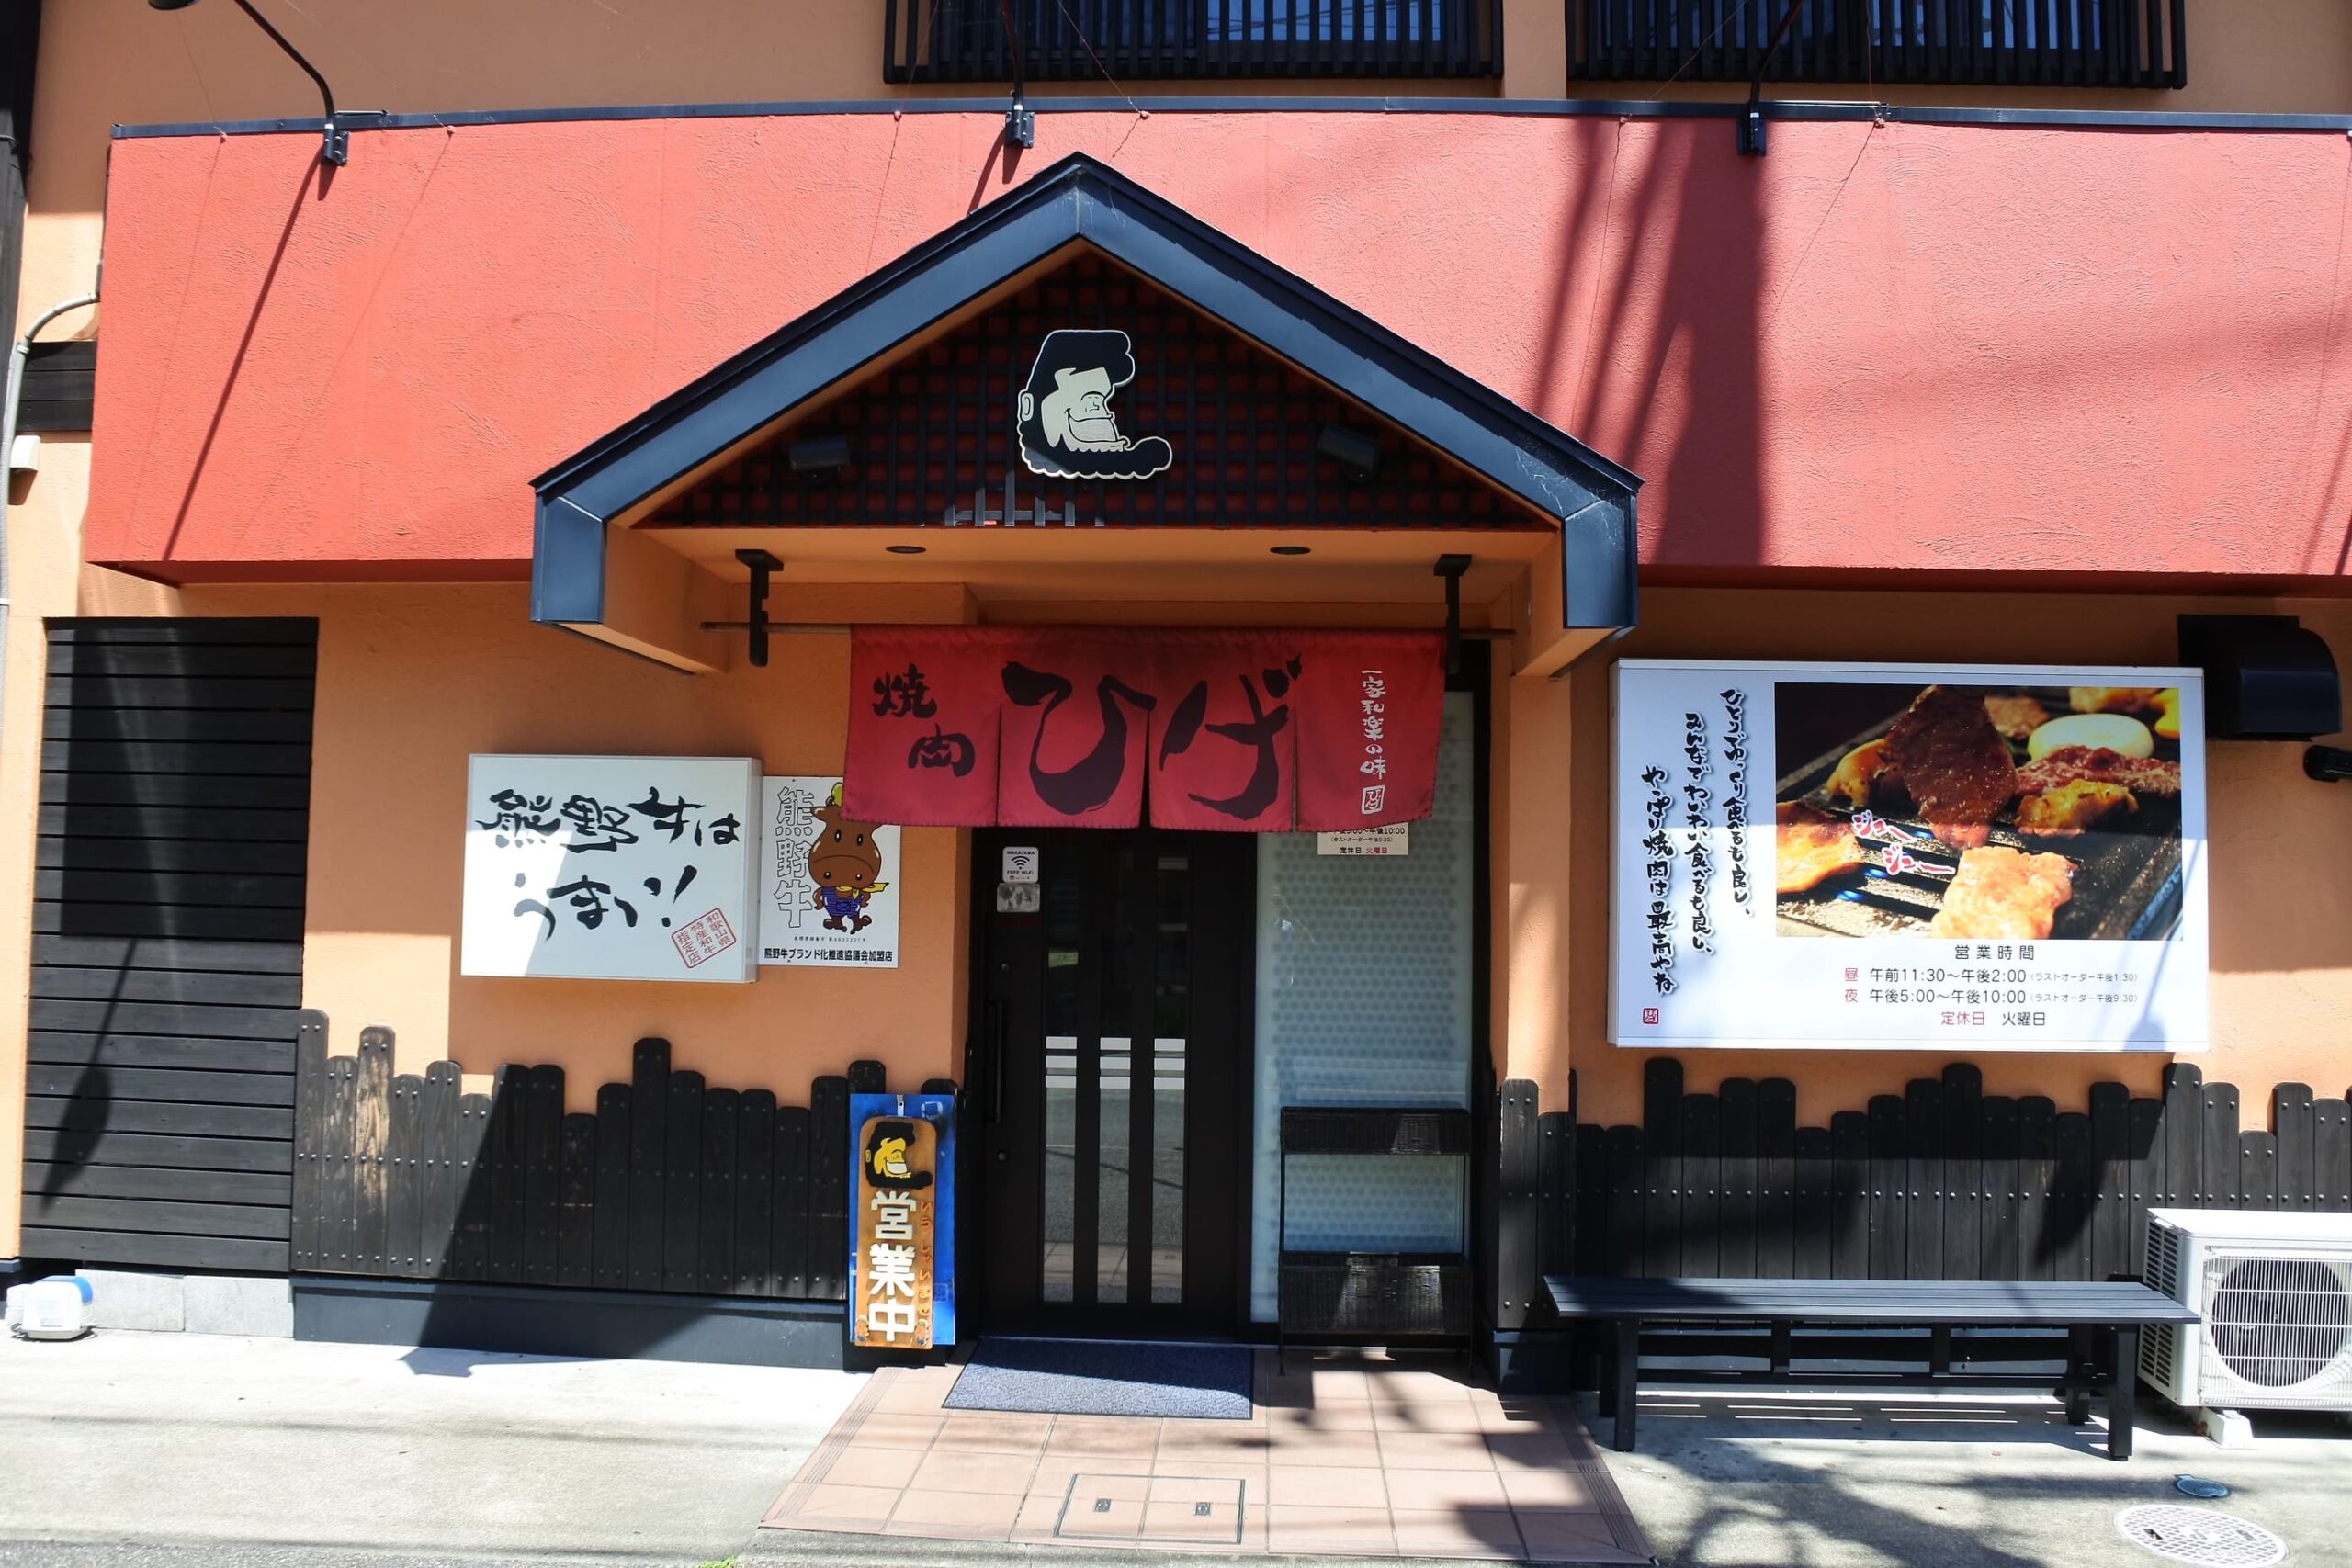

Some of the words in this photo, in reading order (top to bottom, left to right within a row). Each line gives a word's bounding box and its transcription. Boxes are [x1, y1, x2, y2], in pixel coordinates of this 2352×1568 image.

[872, 662, 975, 777] 焼肉
[1001, 652, 1302, 820] ひげ
[475, 785, 740, 853] 熊野牛は
[773, 786, 814, 928] 熊野牛
[706, 912, 731, 947] 和歌山県
[676, 930, 701, 964] 指定店
[764, 948, 892, 962] 熊野牛ブランド化推進協議会加盟店
[1954, 945, 2035, 960] 営業時間
[1844, 967, 1859, 982] 昼
[1844, 988, 1859, 1003] 夜
[1940, 1011, 1985, 1026] 定休日
[2002, 1011, 2045, 1027] 火曜日
[868, 1190, 917, 1342] 営業中
